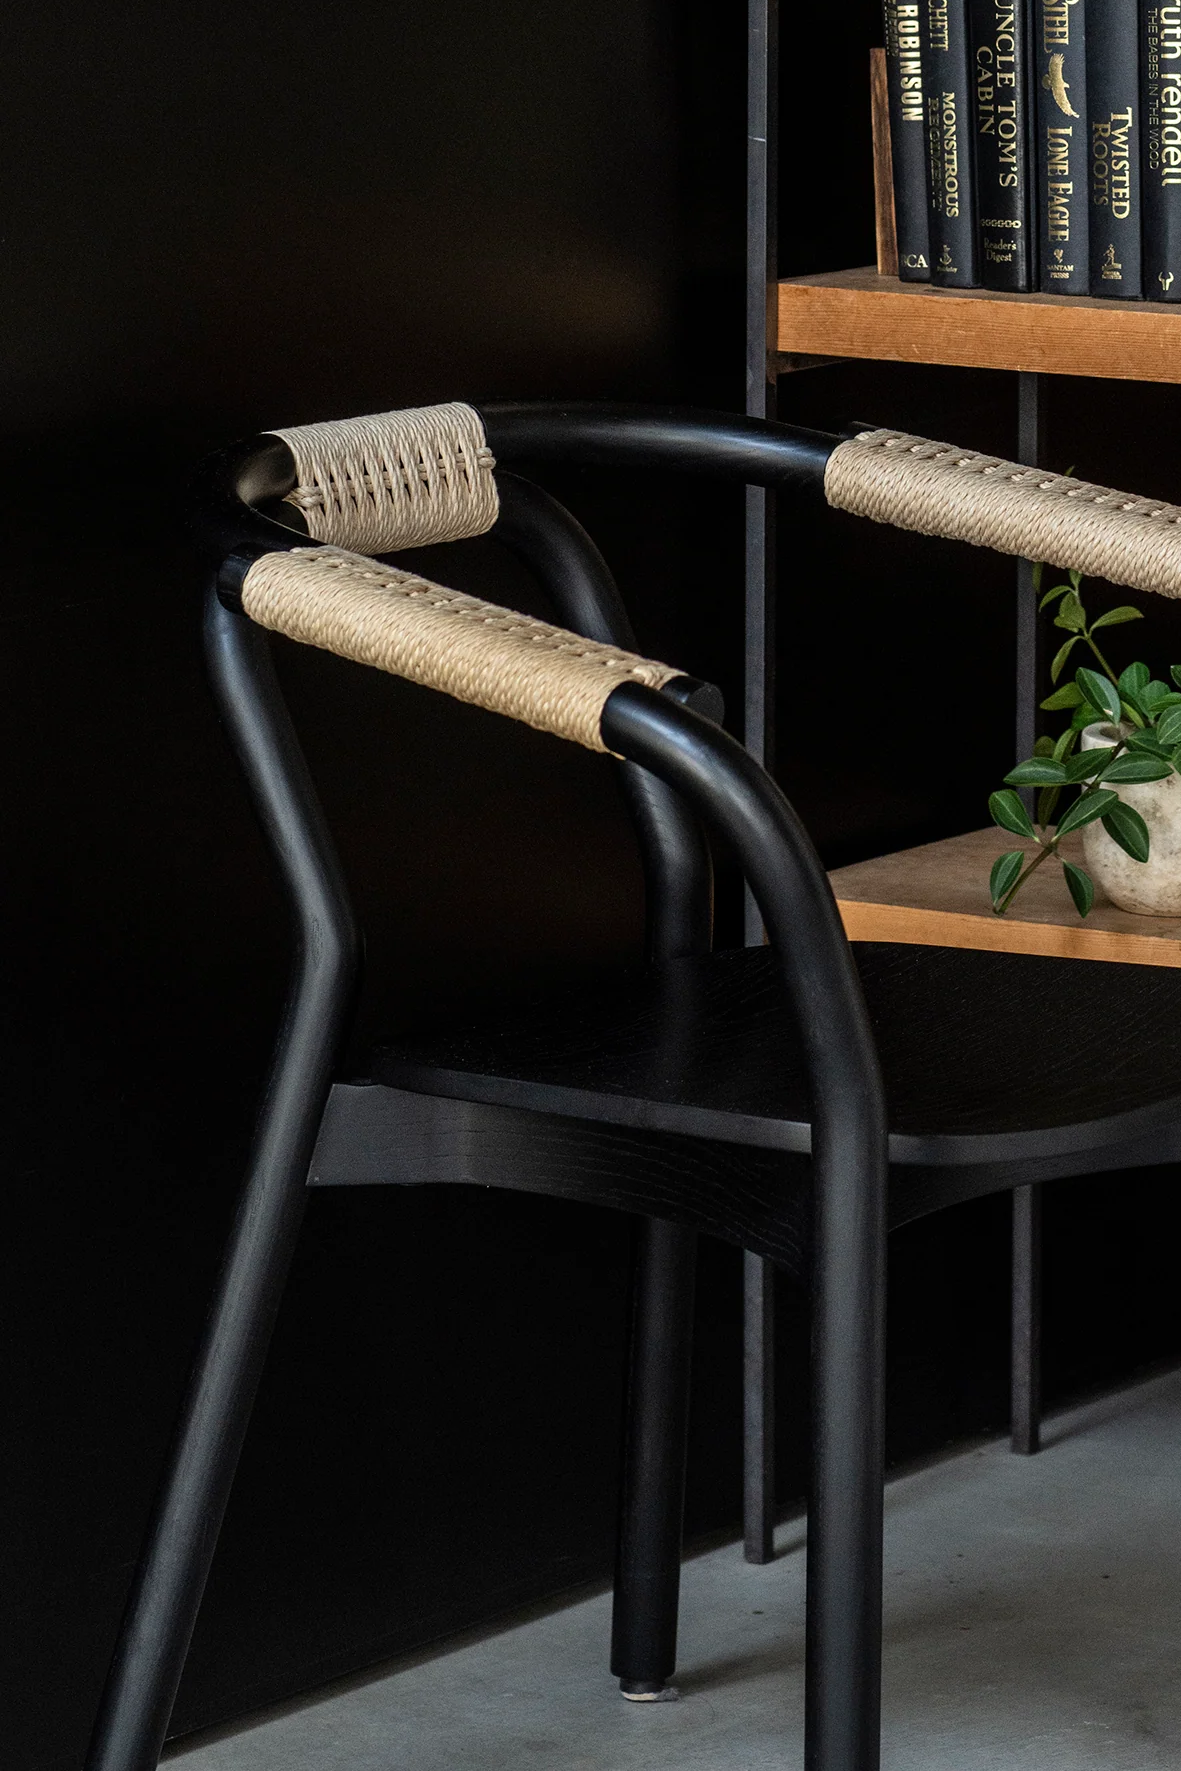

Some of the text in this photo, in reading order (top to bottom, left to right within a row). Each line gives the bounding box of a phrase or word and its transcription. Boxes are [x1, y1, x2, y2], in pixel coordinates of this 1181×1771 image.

[897, 5, 923, 121] ROBINSON
[977, 45, 995, 135] CABIN
[1147, 8, 1159, 170] THE BABES IN THE WOOD
[942, 92, 959, 217] MONSTROUS
[998, 100, 1018, 187] TOM'S
[1047, 126, 1073, 242] LONE EAGLE
[1092, 121, 1111, 206] ROOTS
[1110, 106, 1133, 219] TWISTED
[984, 237, 1017, 251] Reader's
[986, 249, 1013, 263] Digest
